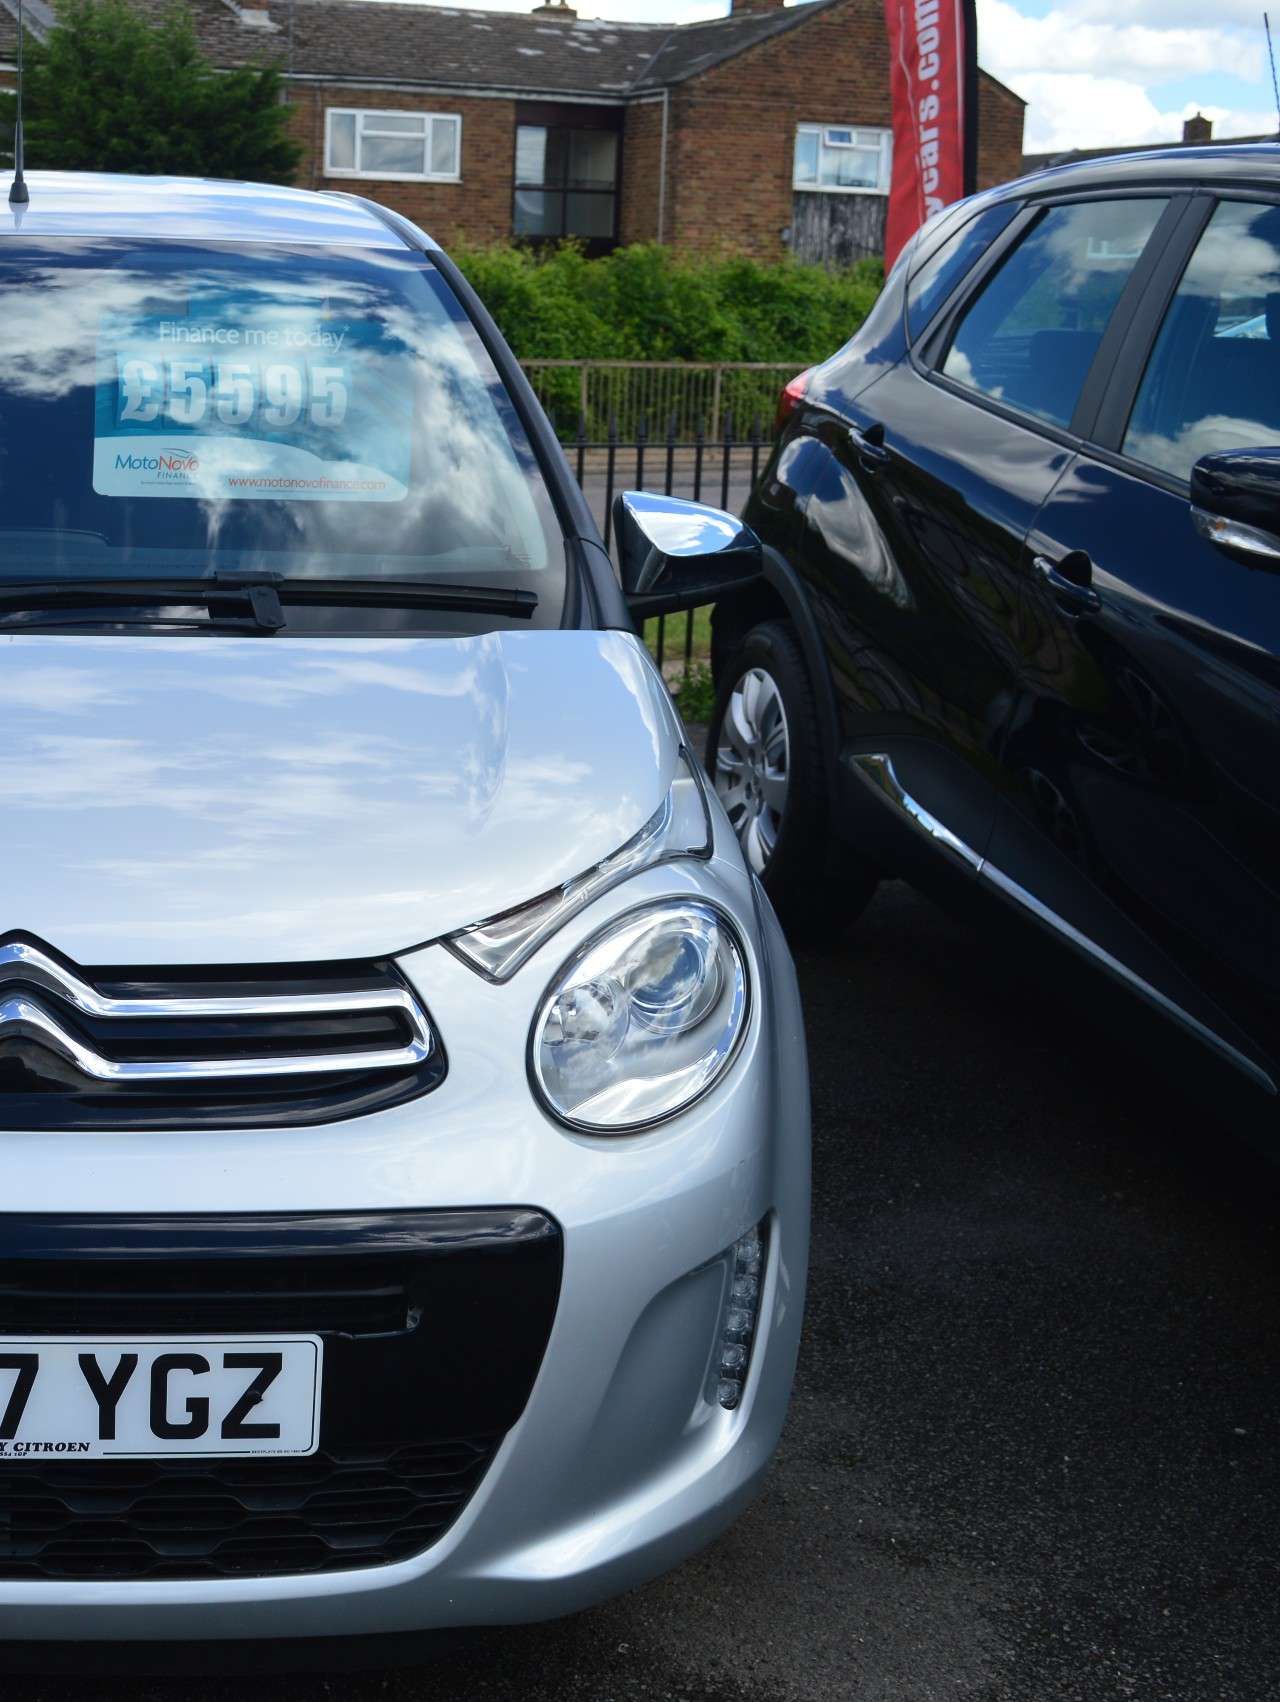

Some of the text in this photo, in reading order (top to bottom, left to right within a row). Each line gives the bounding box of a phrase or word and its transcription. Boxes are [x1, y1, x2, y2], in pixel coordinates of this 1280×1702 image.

[158, 321, 240, 344] Finance
[244, 328, 278, 345] me
[120, 359, 348, 428] £5595
[114, 454, 199, 471] MotoNovo
[78, 1352, 284, 1440] YGZ
[13, 1442, 90, 1452] CITROEN
